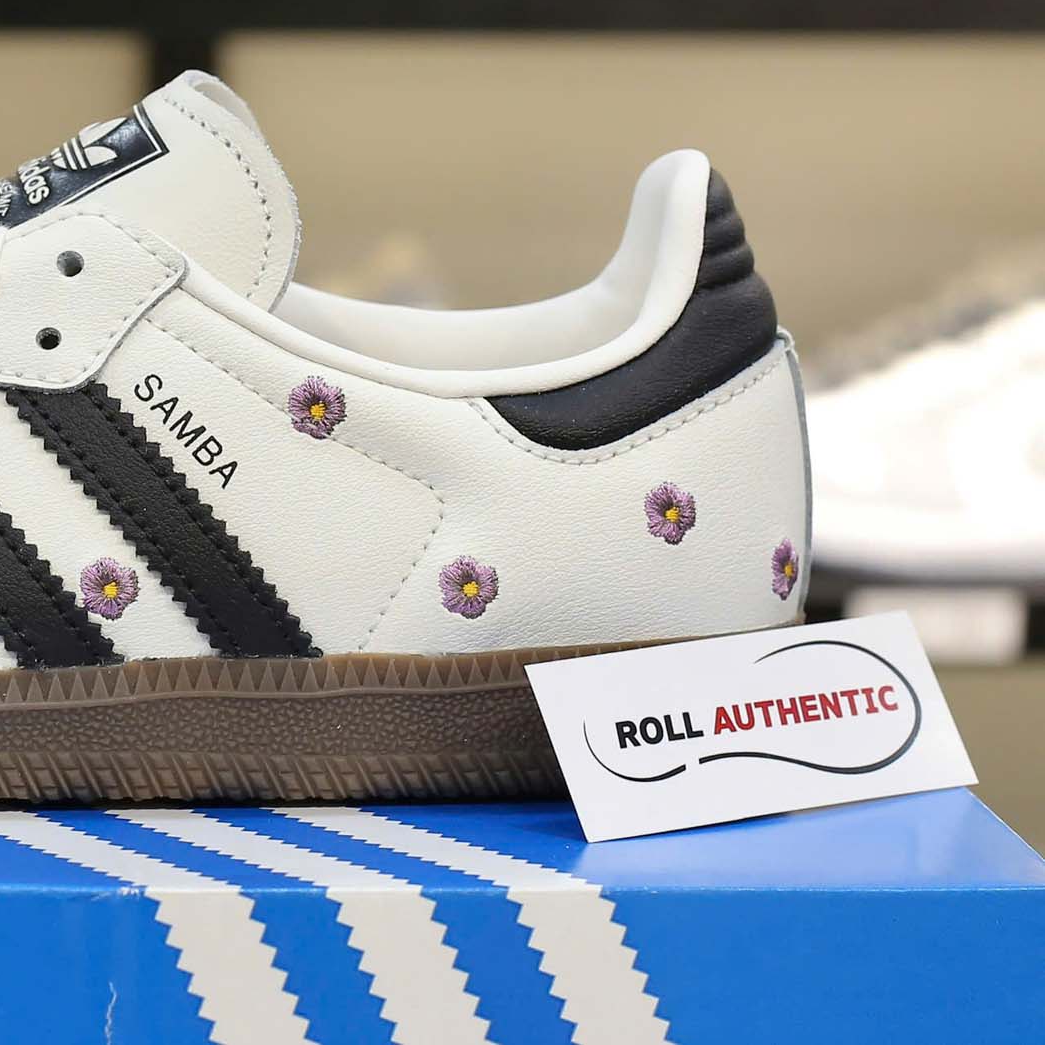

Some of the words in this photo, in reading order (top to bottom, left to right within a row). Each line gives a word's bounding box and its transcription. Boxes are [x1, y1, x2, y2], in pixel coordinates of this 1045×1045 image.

[134, 374, 238, 489] SAMBA
[616, 712, 703, 749] ROLL
[714, 685, 899, 735] AUTHENTIC
